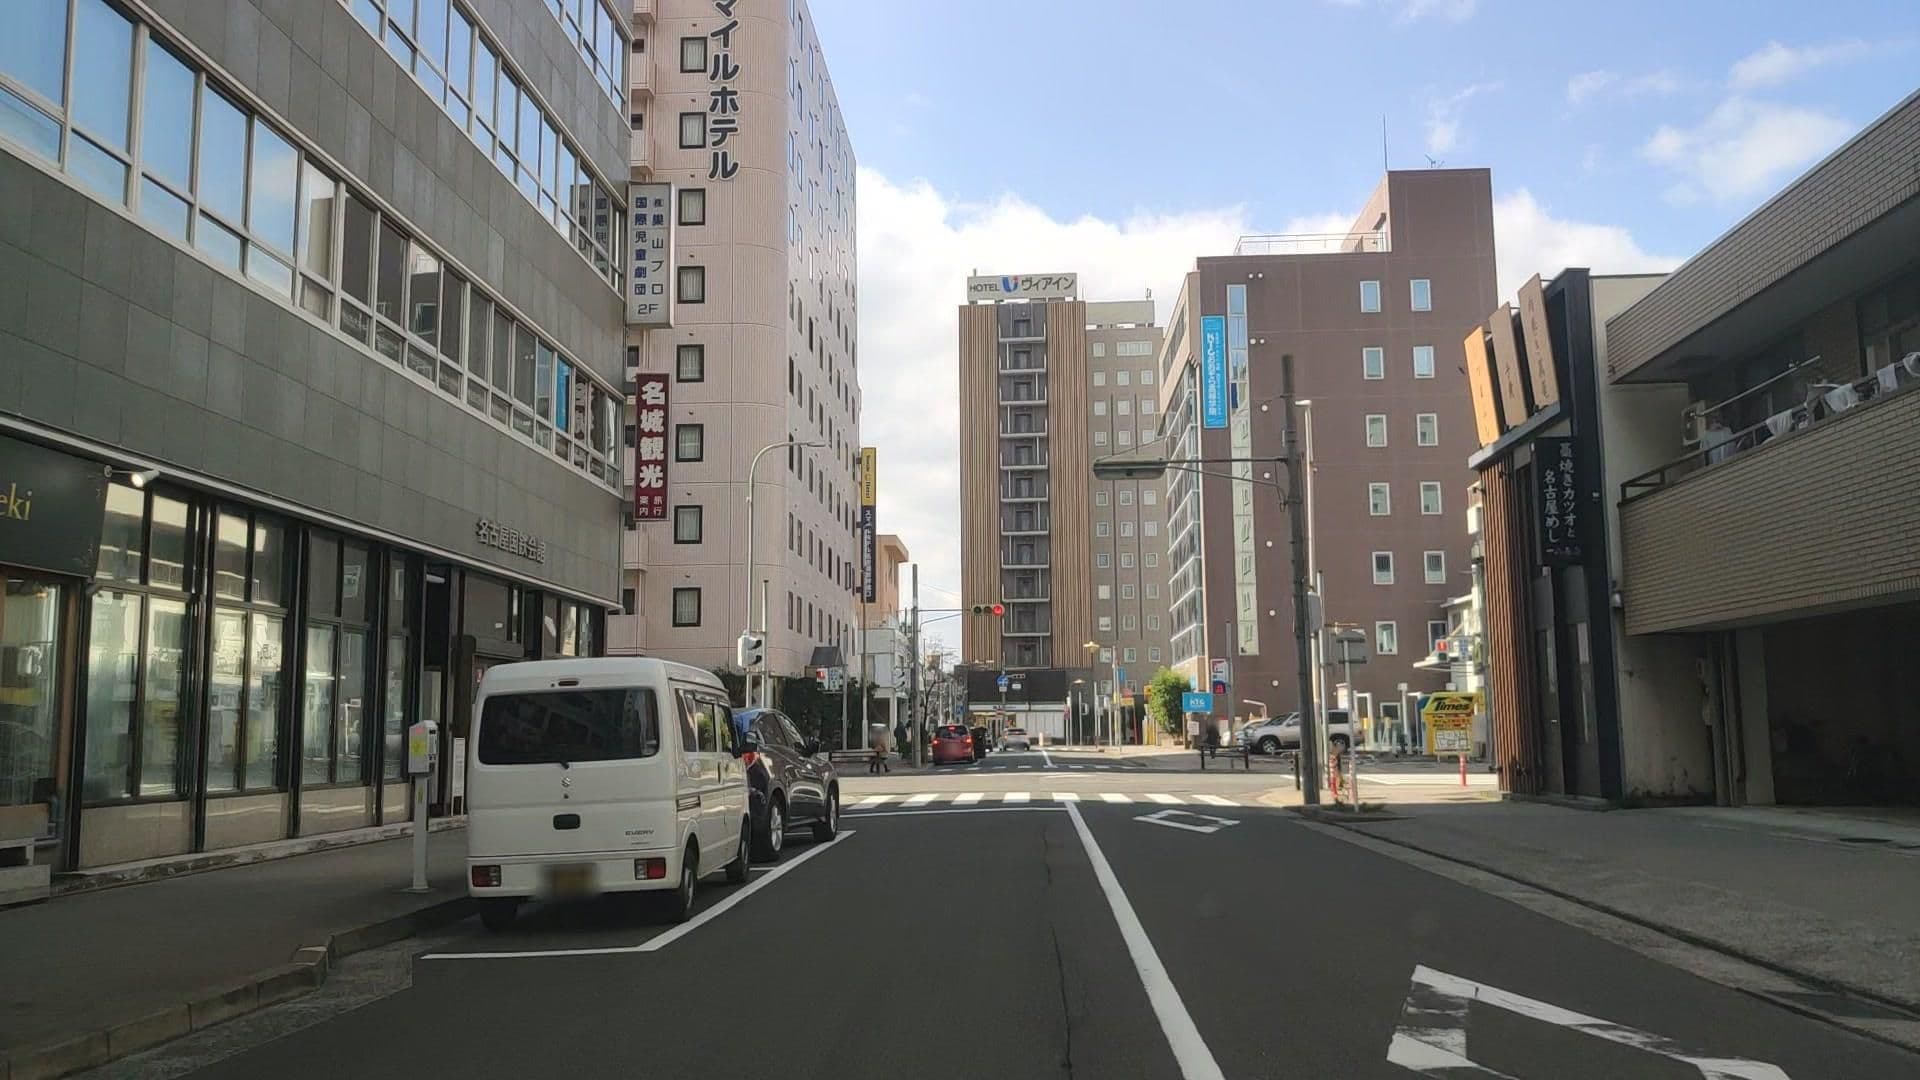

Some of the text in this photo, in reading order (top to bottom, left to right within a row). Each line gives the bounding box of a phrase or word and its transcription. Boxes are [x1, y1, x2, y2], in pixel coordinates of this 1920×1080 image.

[635, 196, 647, 295] 国際児童劇団
[970, 276, 1074, 292] HOTEL ヴィアイン
[637, 303, 659, 315] 2F
[1544, 469, 1560, 543] 名古屋めし
[1434, 701, 1470, 711] Times
